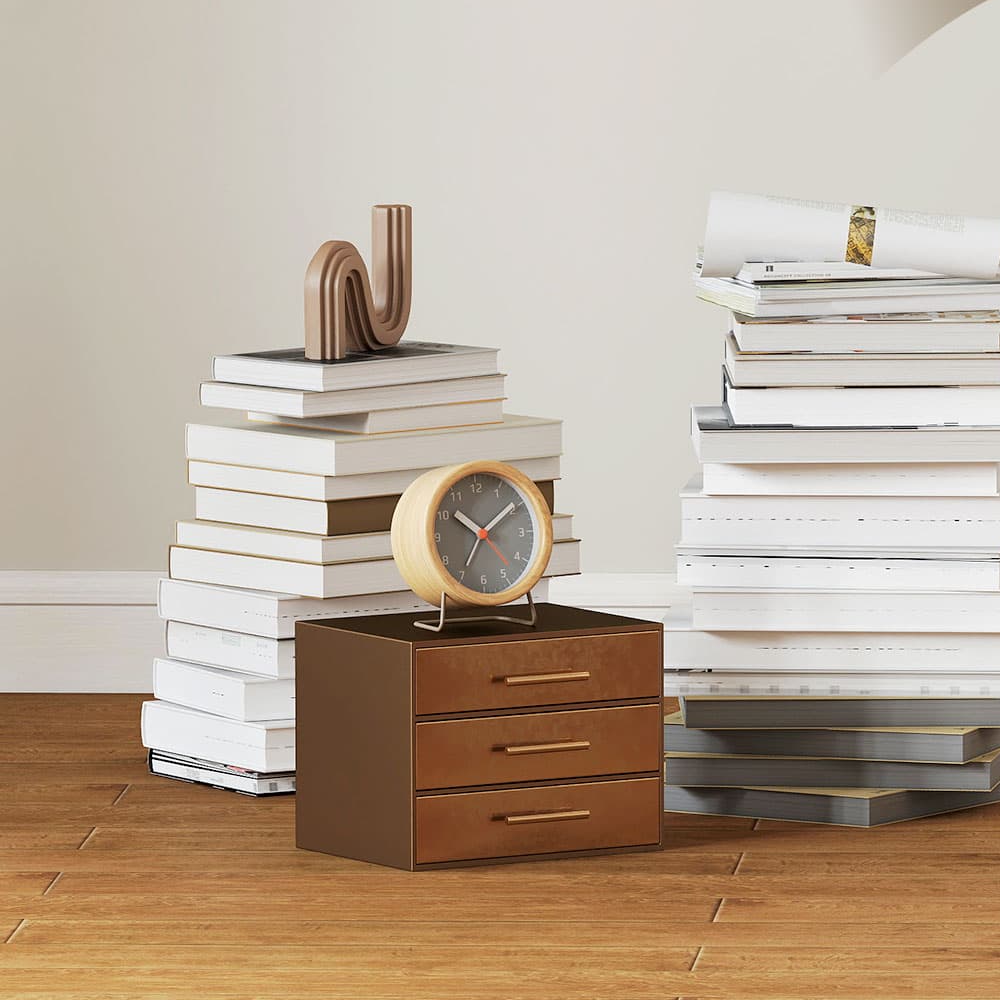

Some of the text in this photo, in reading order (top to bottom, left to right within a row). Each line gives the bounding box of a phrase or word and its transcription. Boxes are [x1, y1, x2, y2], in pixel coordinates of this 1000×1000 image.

[470, 484, 481, 493] 12
[451, 492, 462, 501] 11
[495, 489, 499, 498] 1
[438, 511, 449, 520] 10
[518, 528, 524, 537] 3
[435, 533, 440, 542] 9
[443, 556, 448, 565] 8
[514, 552, 520, 560] 4
[459, 571, 464, 580] 7
[501, 569, 507, 578] 5
[481, 575, 487, 584] 6
